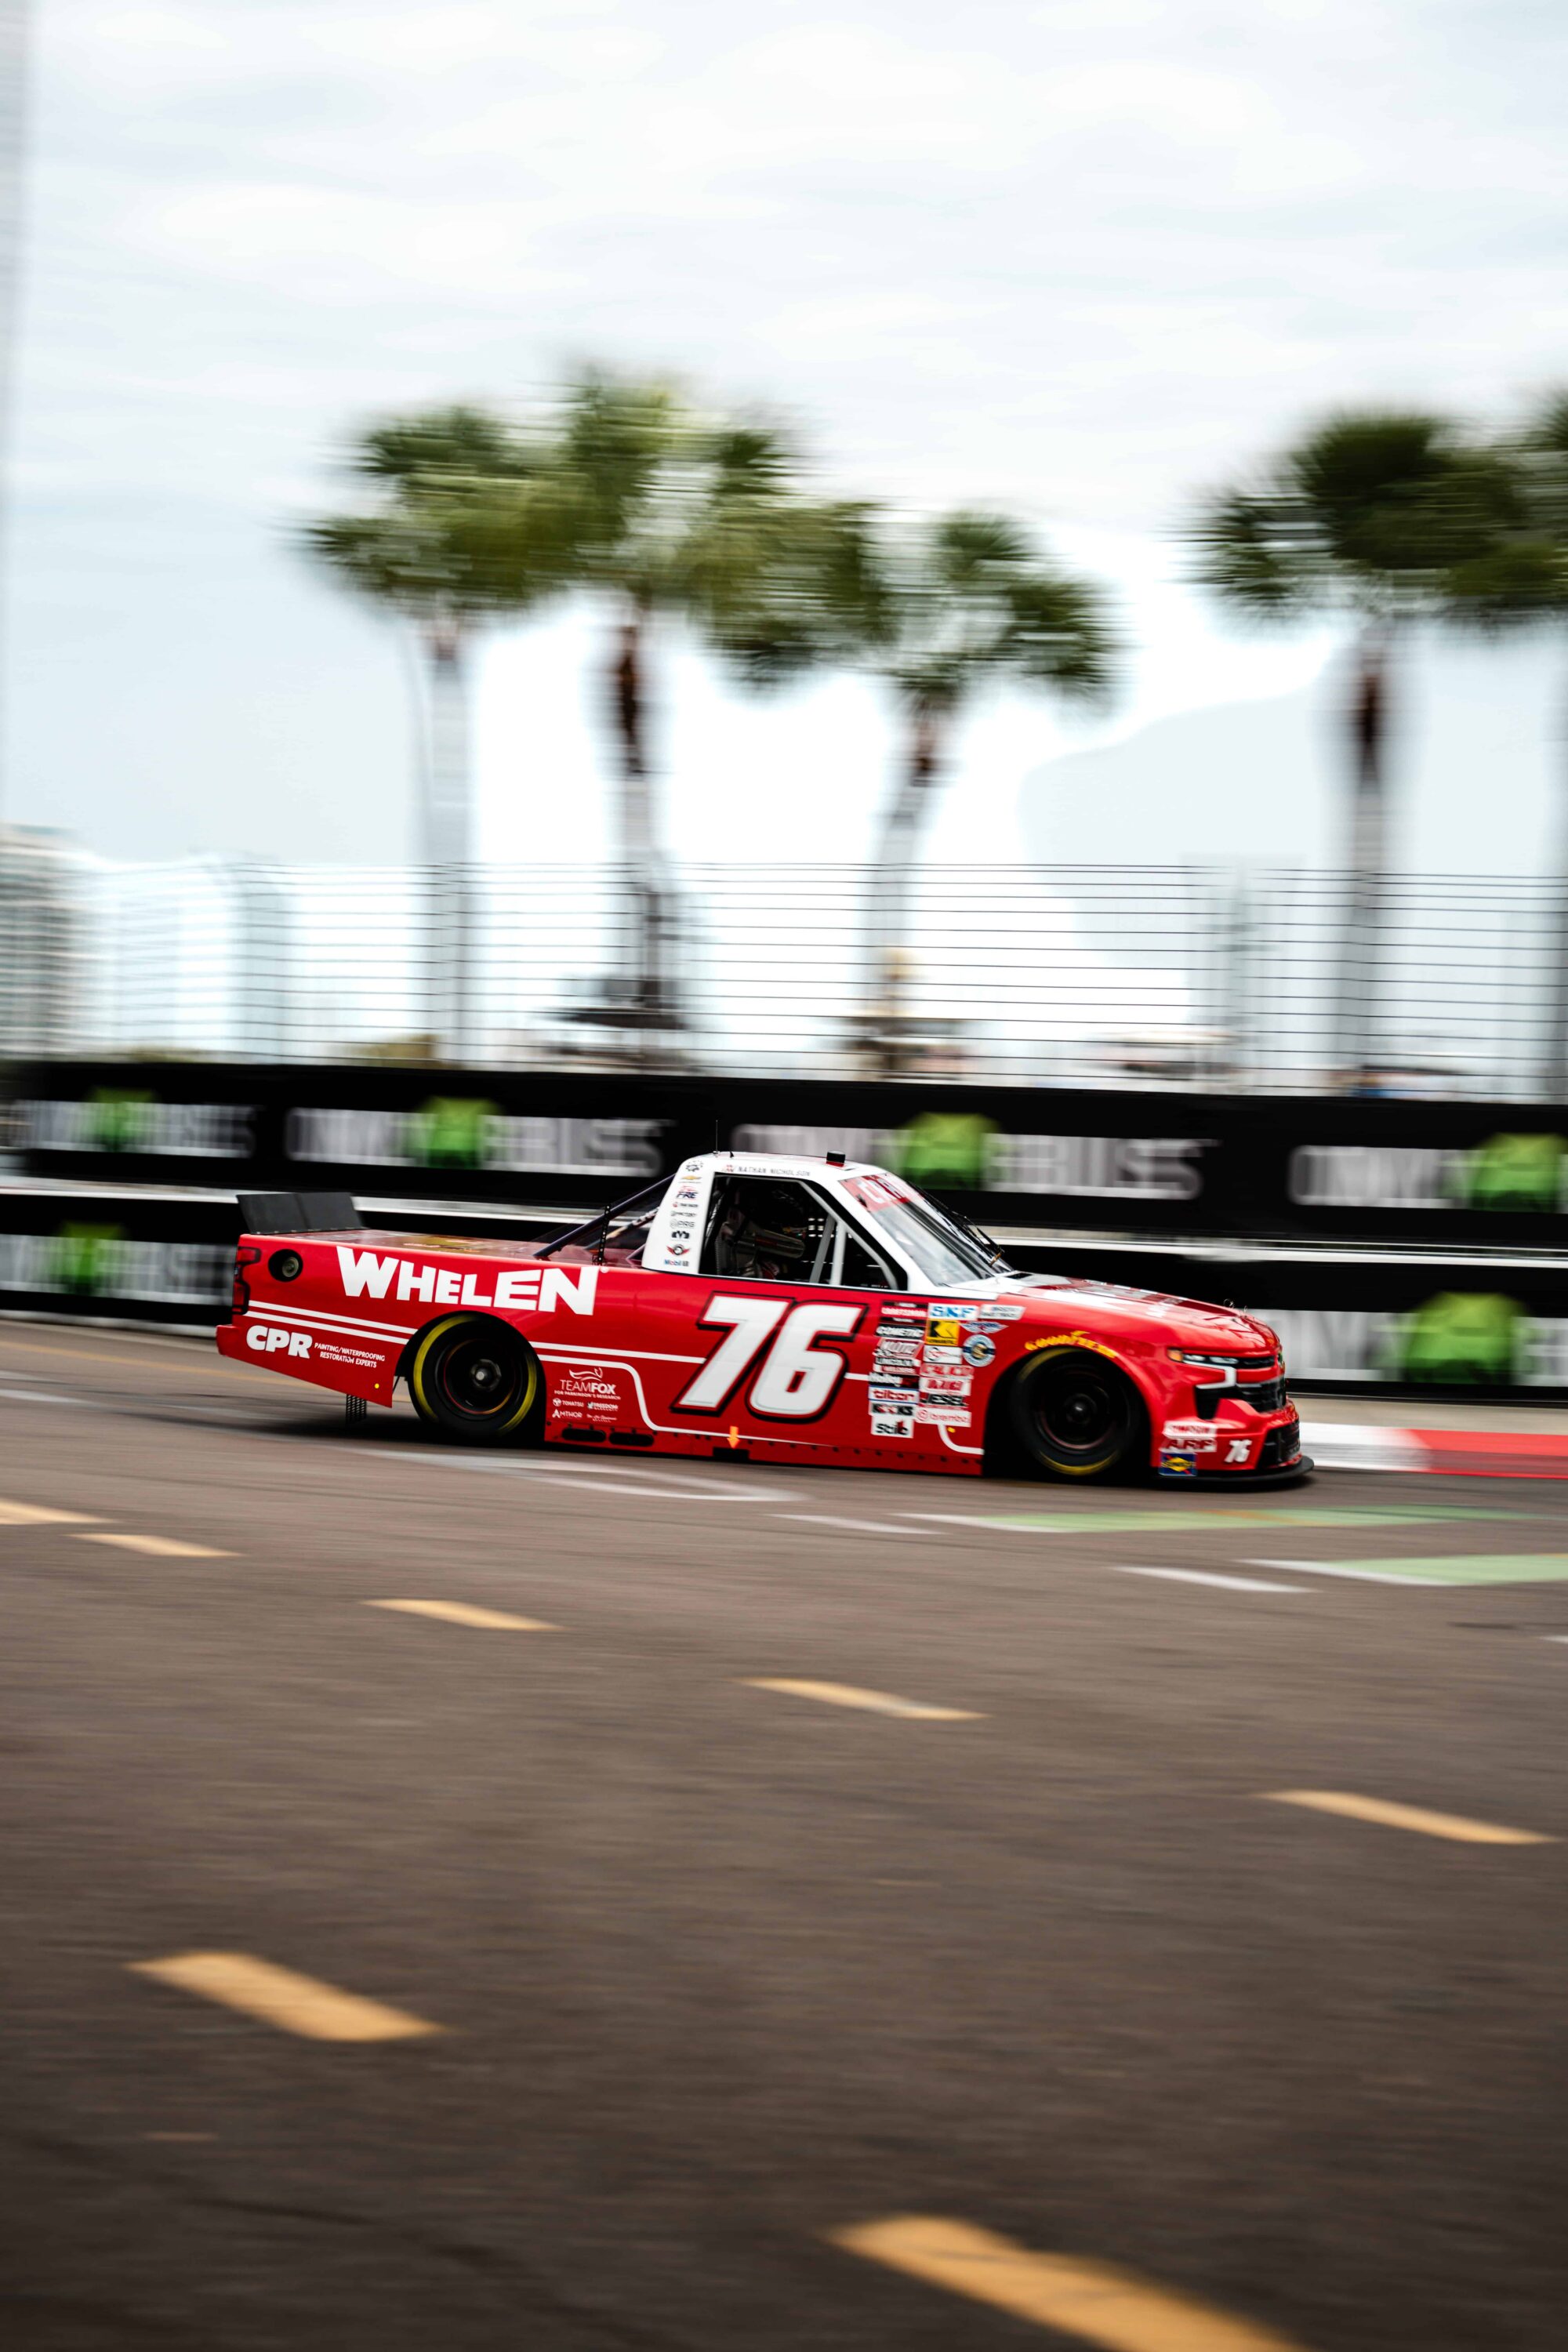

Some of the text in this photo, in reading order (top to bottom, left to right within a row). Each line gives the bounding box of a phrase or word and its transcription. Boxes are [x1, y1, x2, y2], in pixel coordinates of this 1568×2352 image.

[336, 1246, 601, 1316] WHELEN
[246, 1325, 313, 1359] CPR
[314, 1342, 386, 1362] PAINTING/WATERPROOFING
[320, 1351, 377, 1368] RESTORATION EXPERTS
[672, 1292, 867, 1423] 76
[1225, 1439, 1253, 1463] 76
